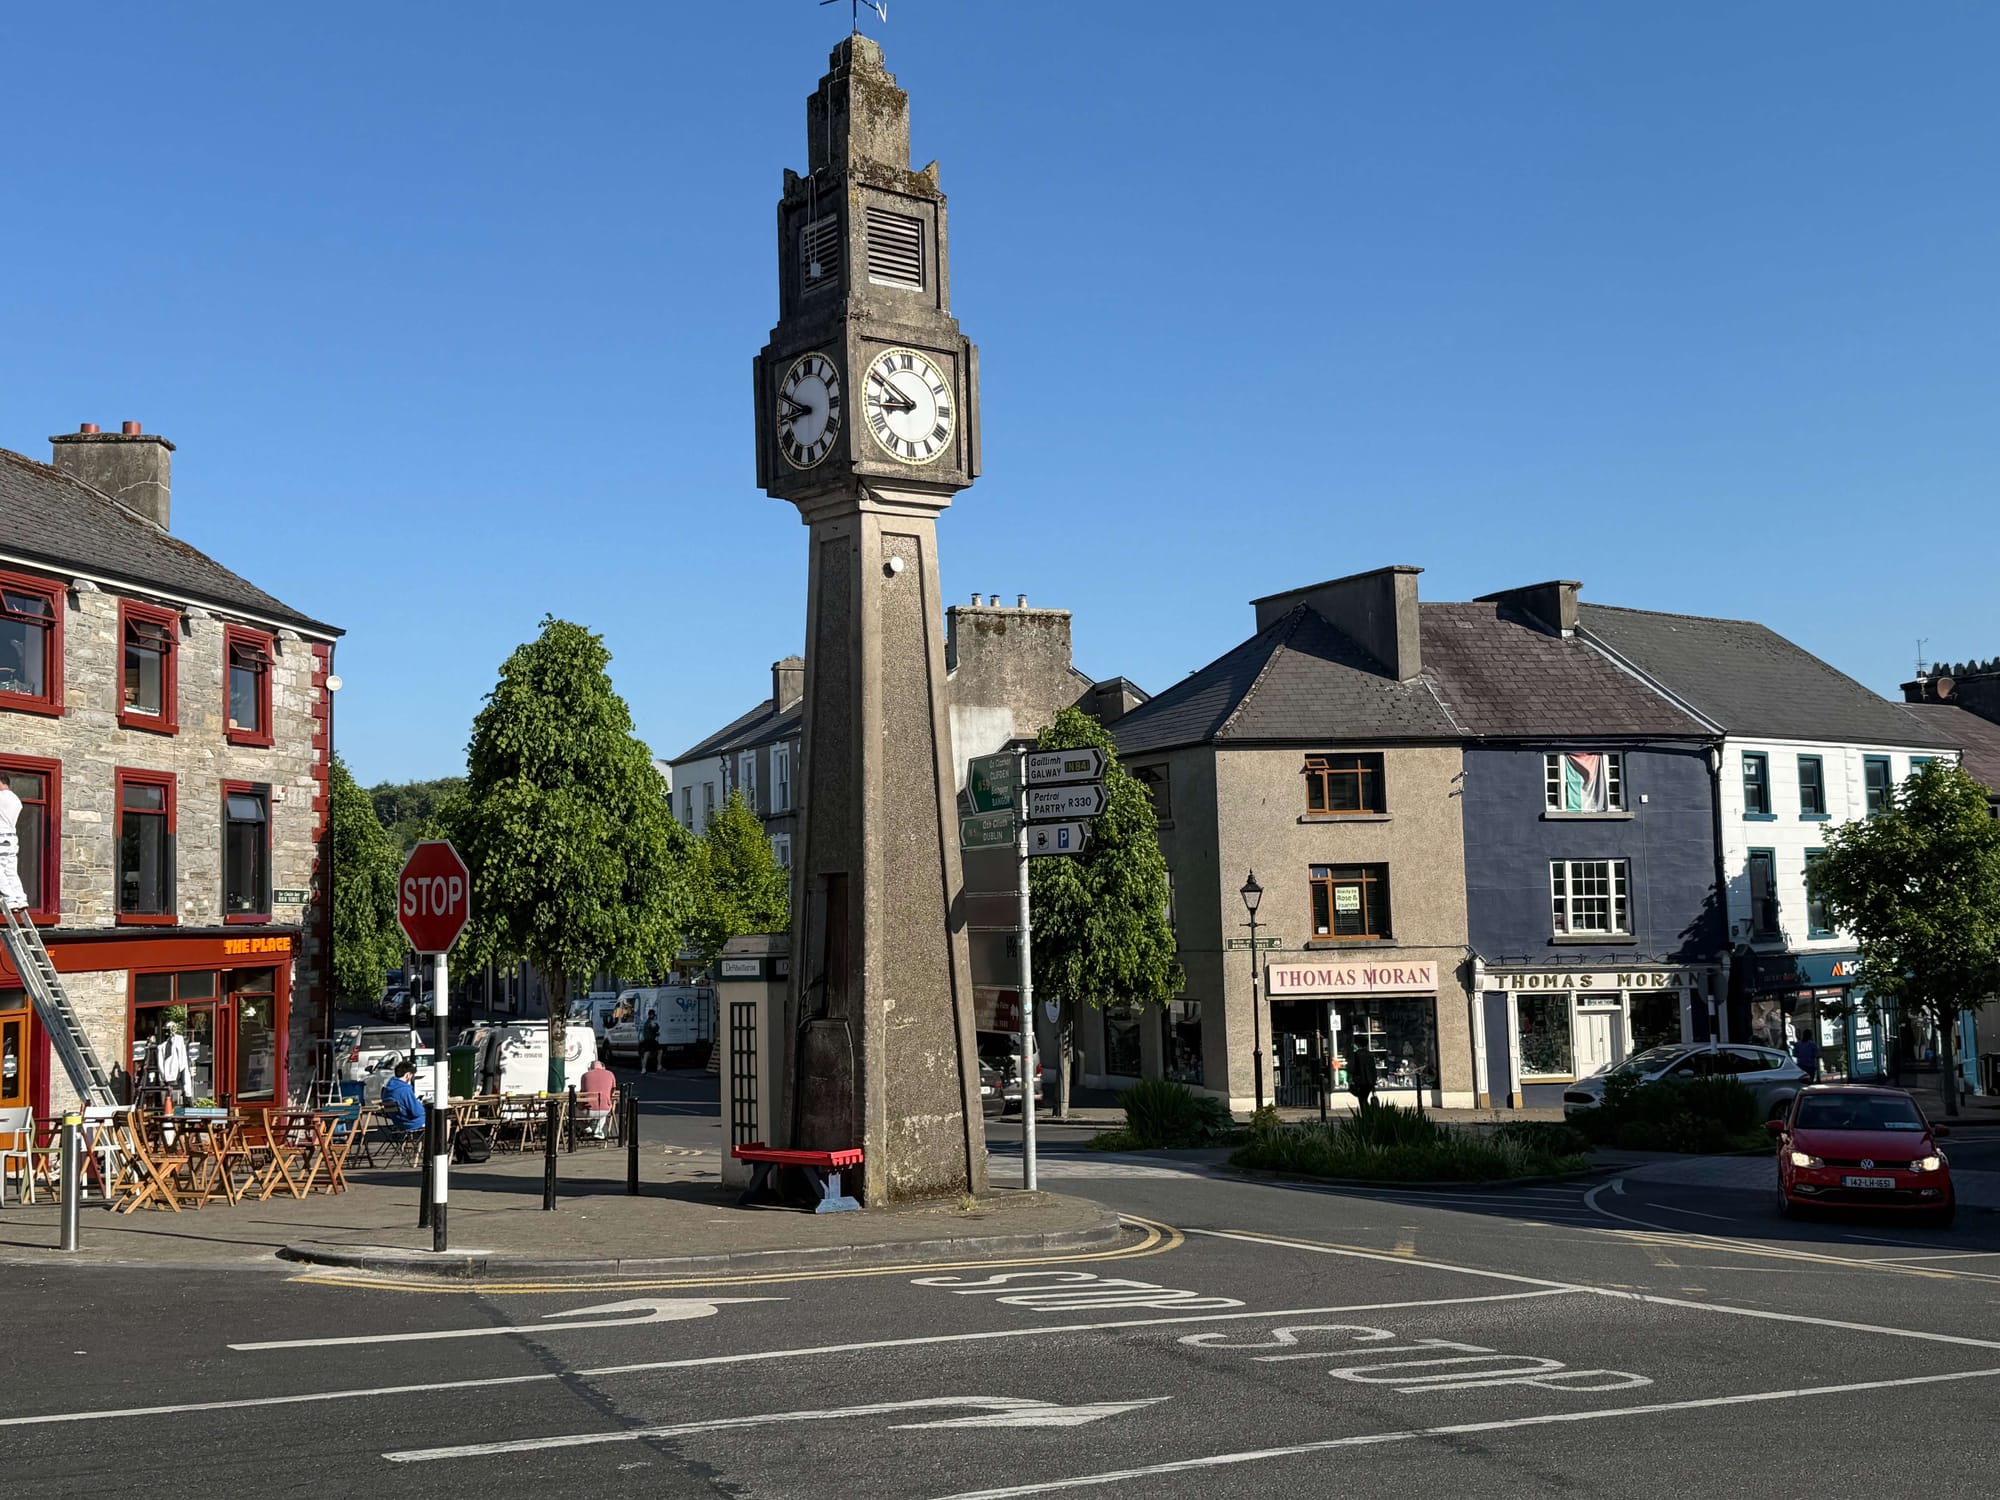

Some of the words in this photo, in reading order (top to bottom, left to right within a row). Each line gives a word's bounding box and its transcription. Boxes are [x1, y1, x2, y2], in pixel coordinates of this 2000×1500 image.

[883, 357, 896, 374] XI
[900, 354, 913, 370] XII
[922, 364, 929, 377] I
[933, 383, 944, 395] II
[938, 405, 950, 418] III
[1031, 757, 1061, 767] Gaillimh
[1068, 761, 1087, 772] N84
[1031, 767, 1062, 779] GALWAY
[1034, 803, 1066, 814] PARTRY
[1068, 796, 1092, 808] R330
[983, 830, 1003, 841] DUBLIN
[403, 875, 463, 917] STOP
[224, 939, 250, 955] THE
[251, 937, 291, 953] PLACE
[1277, 969, 1356, 987] THOMAS
[1363, 967, 1431, 985] MORAN
[1494, 974, 1593, 989] THOMAS
[1617, 971, 1699, 987] MORAN
[1856, 1040, 1872, 1052] LOW
[910, 1271, 1246, 1312] STOP
[1176, 1324, 1654, 1394] STOP
